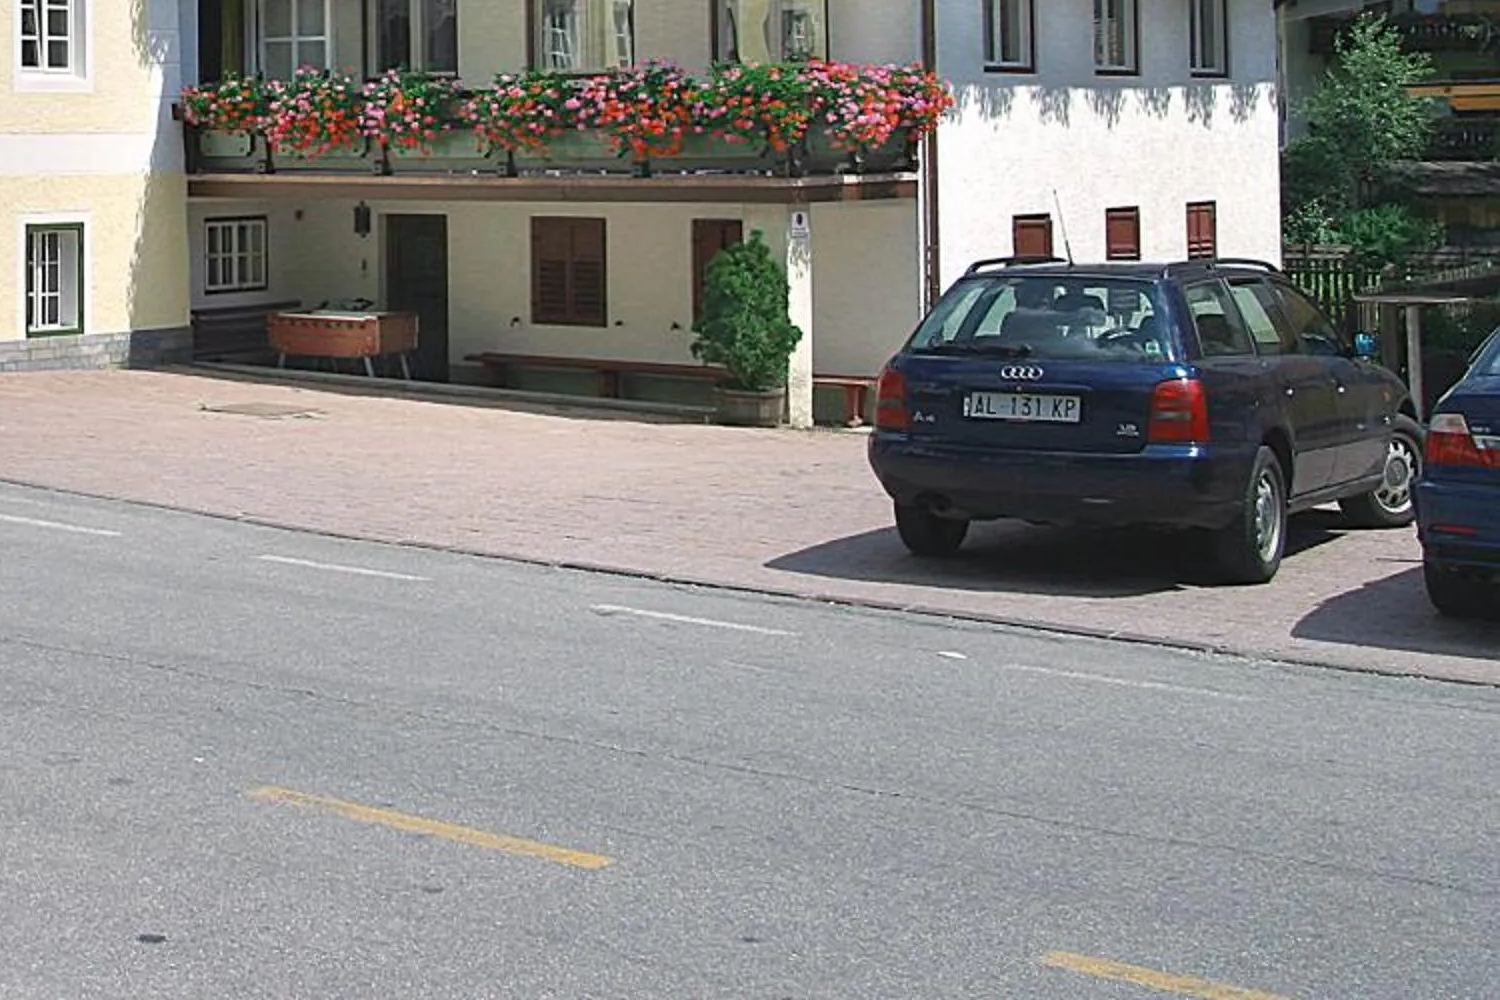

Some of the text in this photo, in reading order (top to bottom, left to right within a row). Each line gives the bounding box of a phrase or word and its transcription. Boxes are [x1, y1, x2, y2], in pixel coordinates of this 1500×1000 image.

[973, 398, 1078, 418] AL 131 KP
